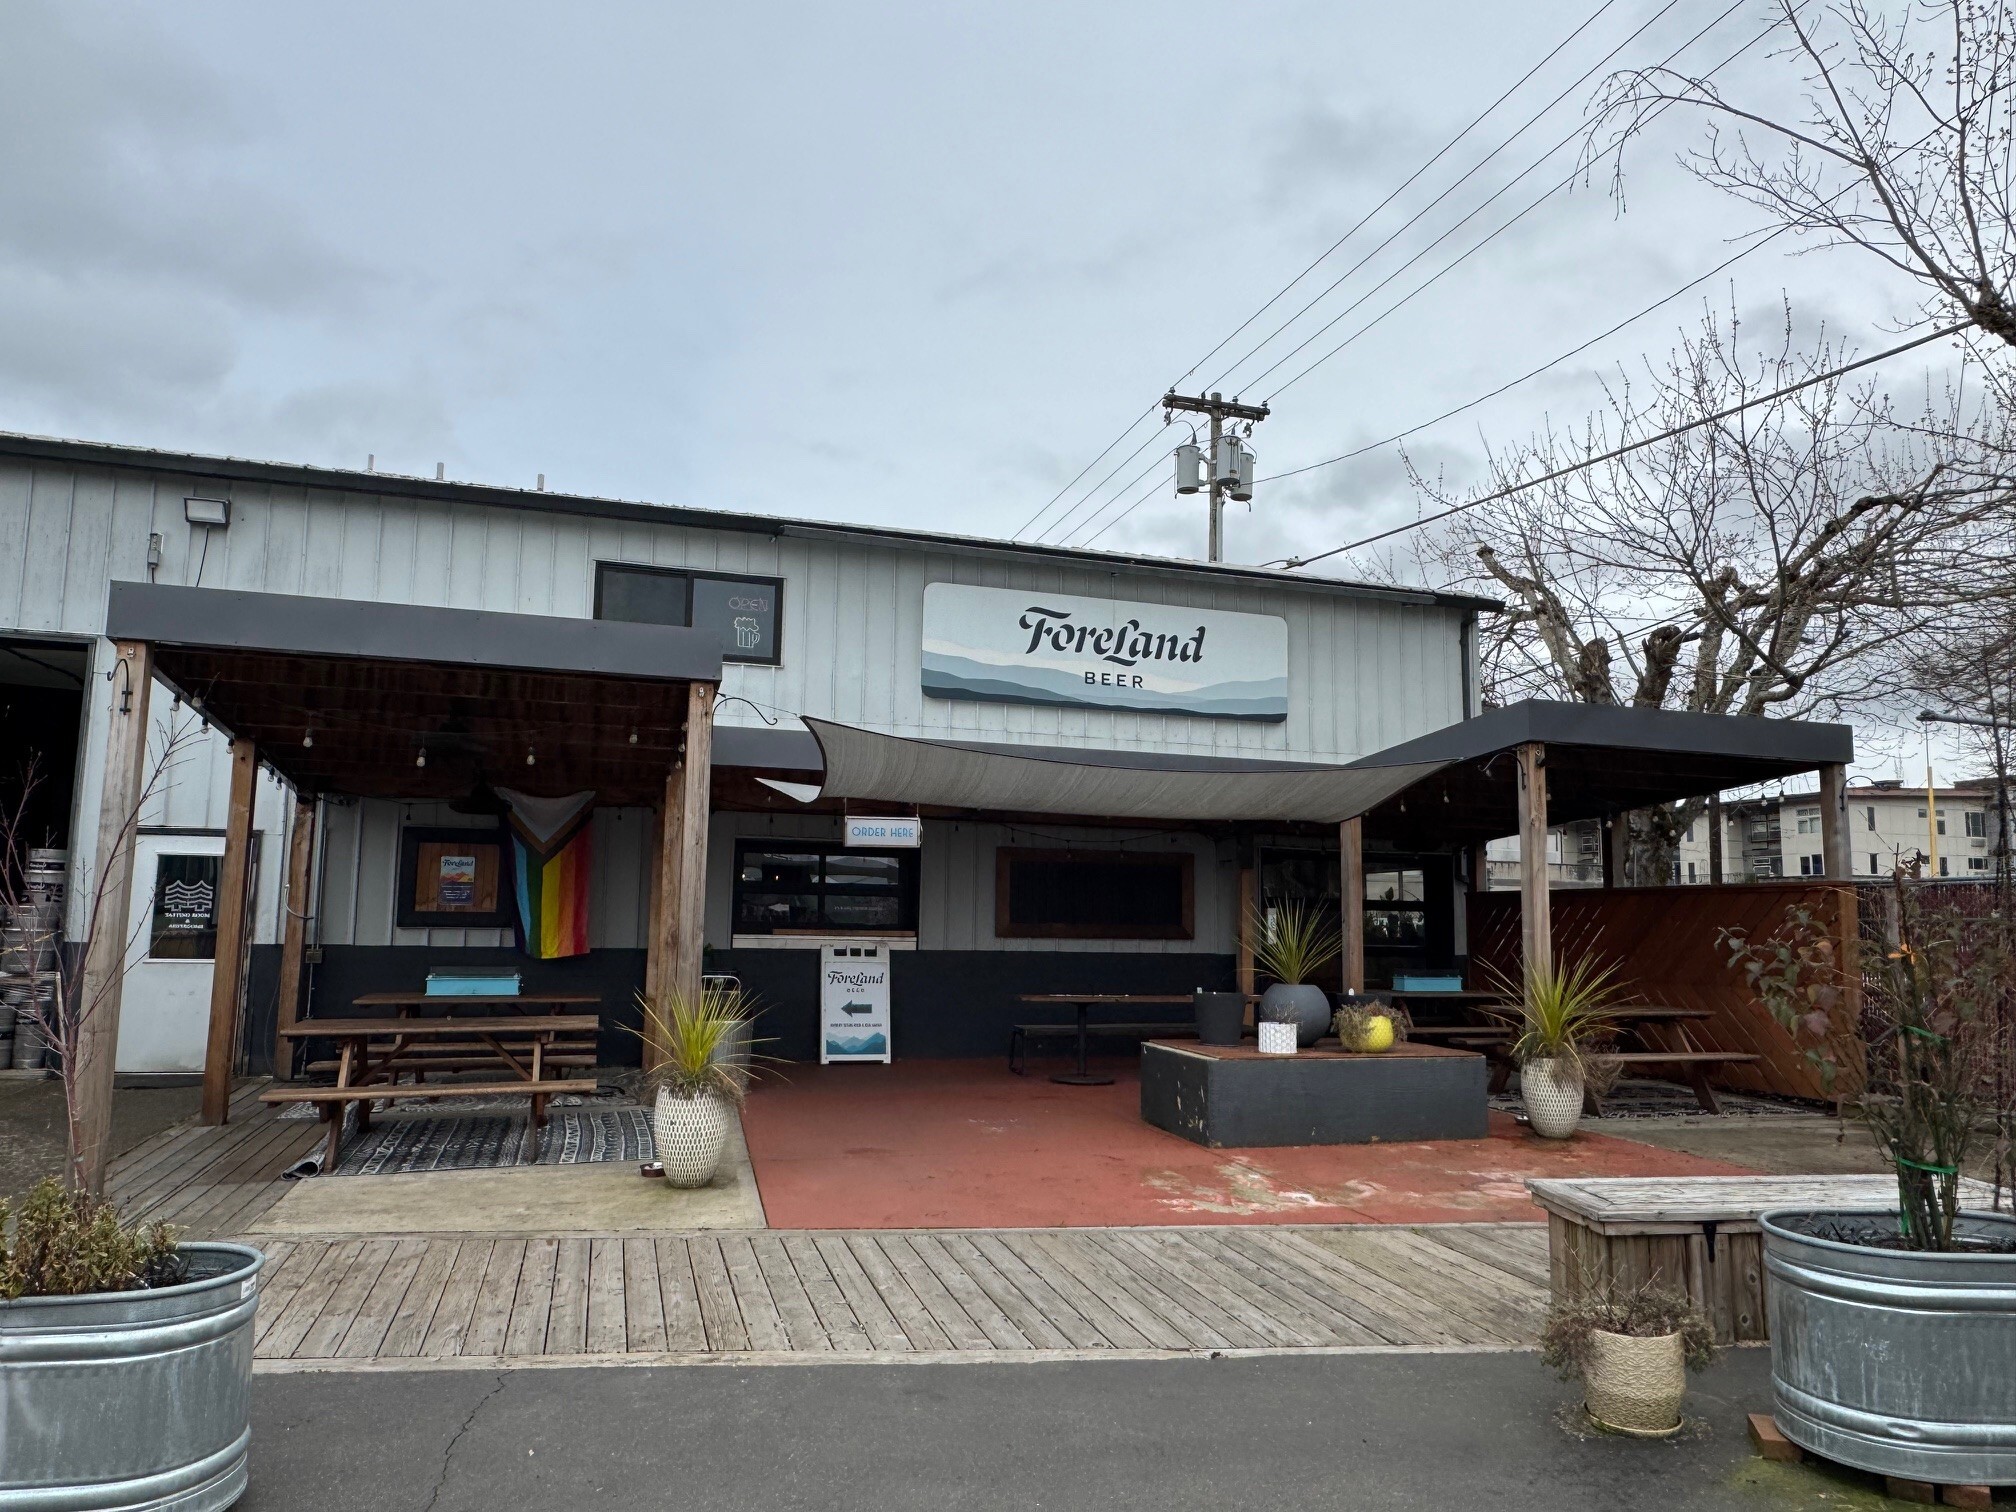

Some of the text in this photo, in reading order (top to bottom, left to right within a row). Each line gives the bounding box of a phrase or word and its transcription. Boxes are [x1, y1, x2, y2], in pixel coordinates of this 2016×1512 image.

[728, 596, 769, 612] OPEN
[1084, 671, 1144, 689] BEER
[851, 826, 914, 838] ORDER HERE
